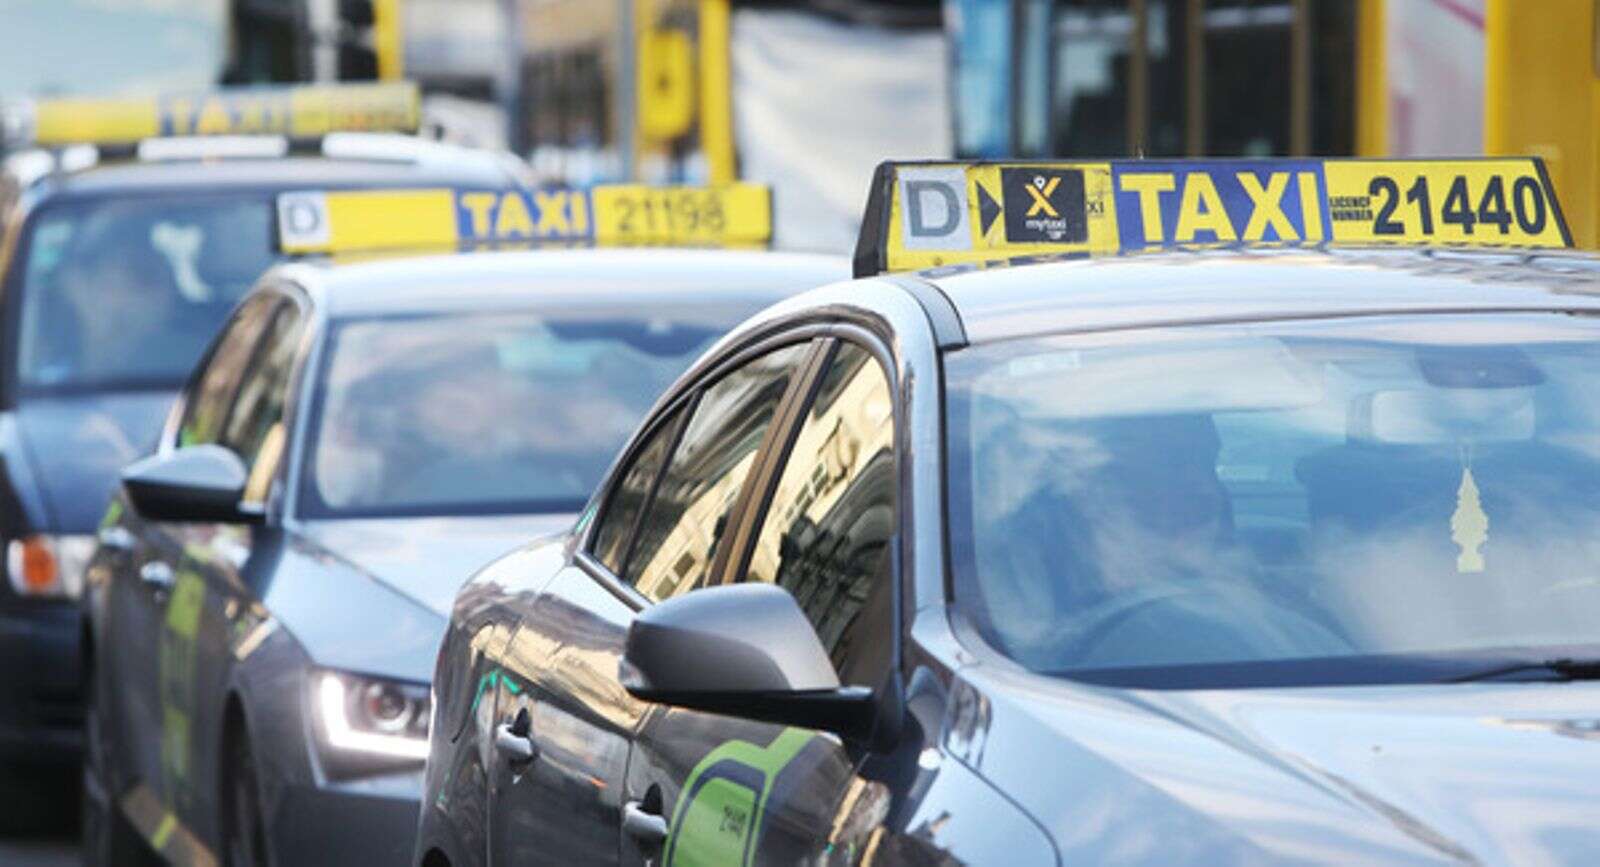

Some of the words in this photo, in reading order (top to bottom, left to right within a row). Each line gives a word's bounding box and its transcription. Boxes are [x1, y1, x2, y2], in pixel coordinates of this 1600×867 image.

[461, 191, 589, 237] TAXI
[614, 197, 726, 233] 21198
[906, 180, 961, 237] D
[1025, 218, 1067, 232] mytaxi
[1119, 172, 1324, 242] TAXI
[1369, 175, 1546, 235] 21440
